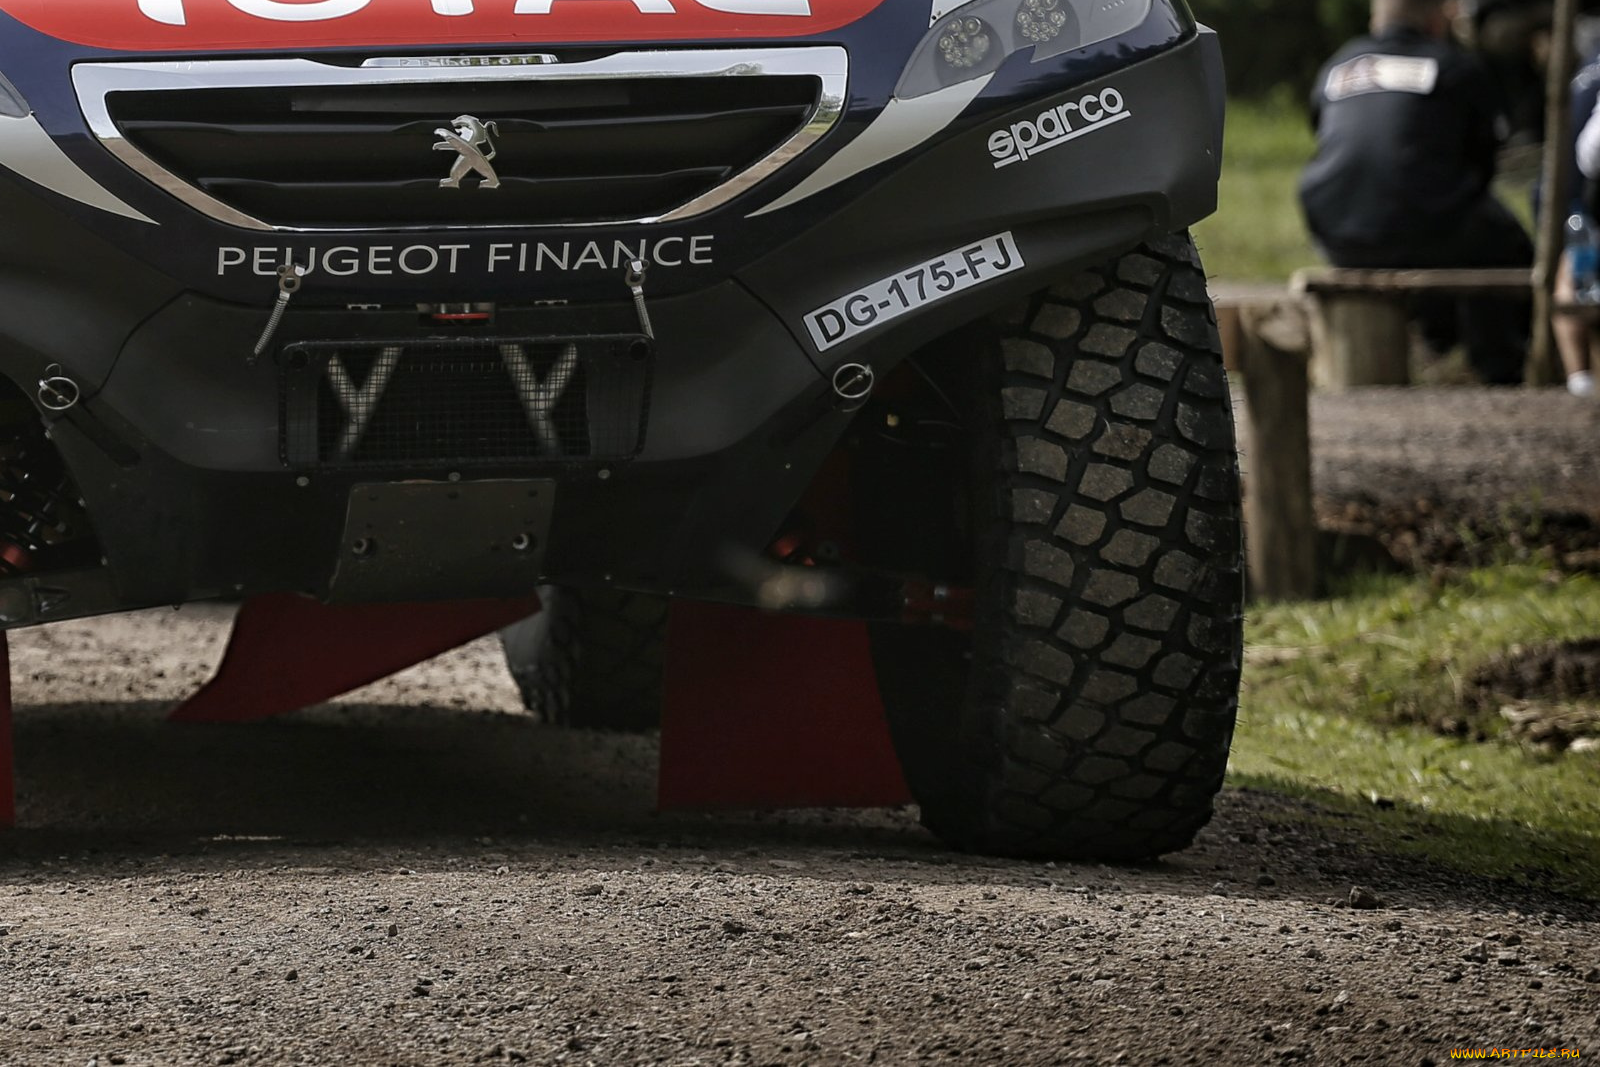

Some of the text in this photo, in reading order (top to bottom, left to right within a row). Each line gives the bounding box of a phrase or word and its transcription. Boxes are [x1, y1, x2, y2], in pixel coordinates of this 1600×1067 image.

[988, 87, 1126, 164] sparco
[217, 234, 715, 276] PEUGEOT FINANCE
[813, 237, 1013, 344] DG-175-FJ
